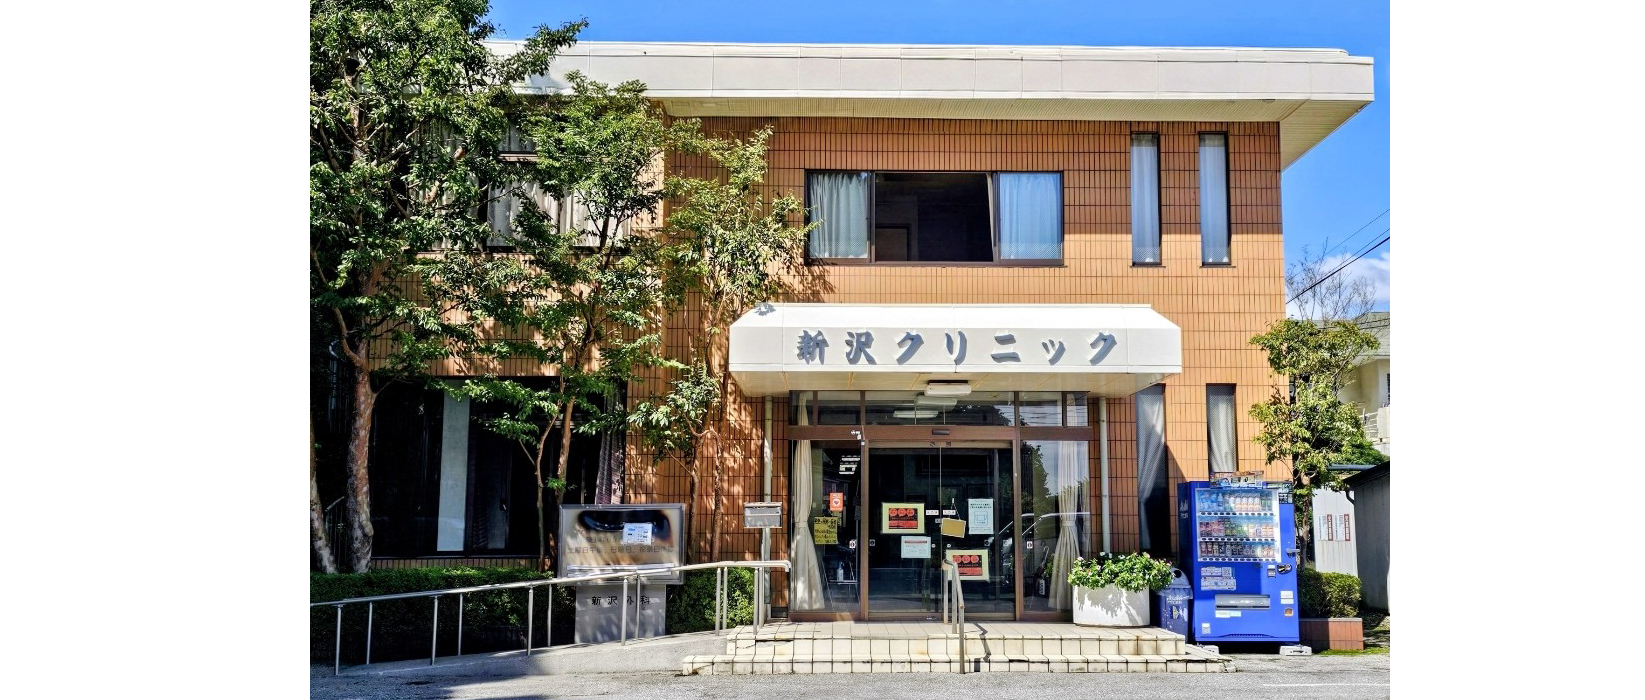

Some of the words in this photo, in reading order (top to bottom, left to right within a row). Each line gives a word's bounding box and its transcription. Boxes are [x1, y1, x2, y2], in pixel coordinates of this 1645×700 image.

[797, 329, 1117, 366] 新沢クリニック
[591, 595, 650, 606] 新沢外科
